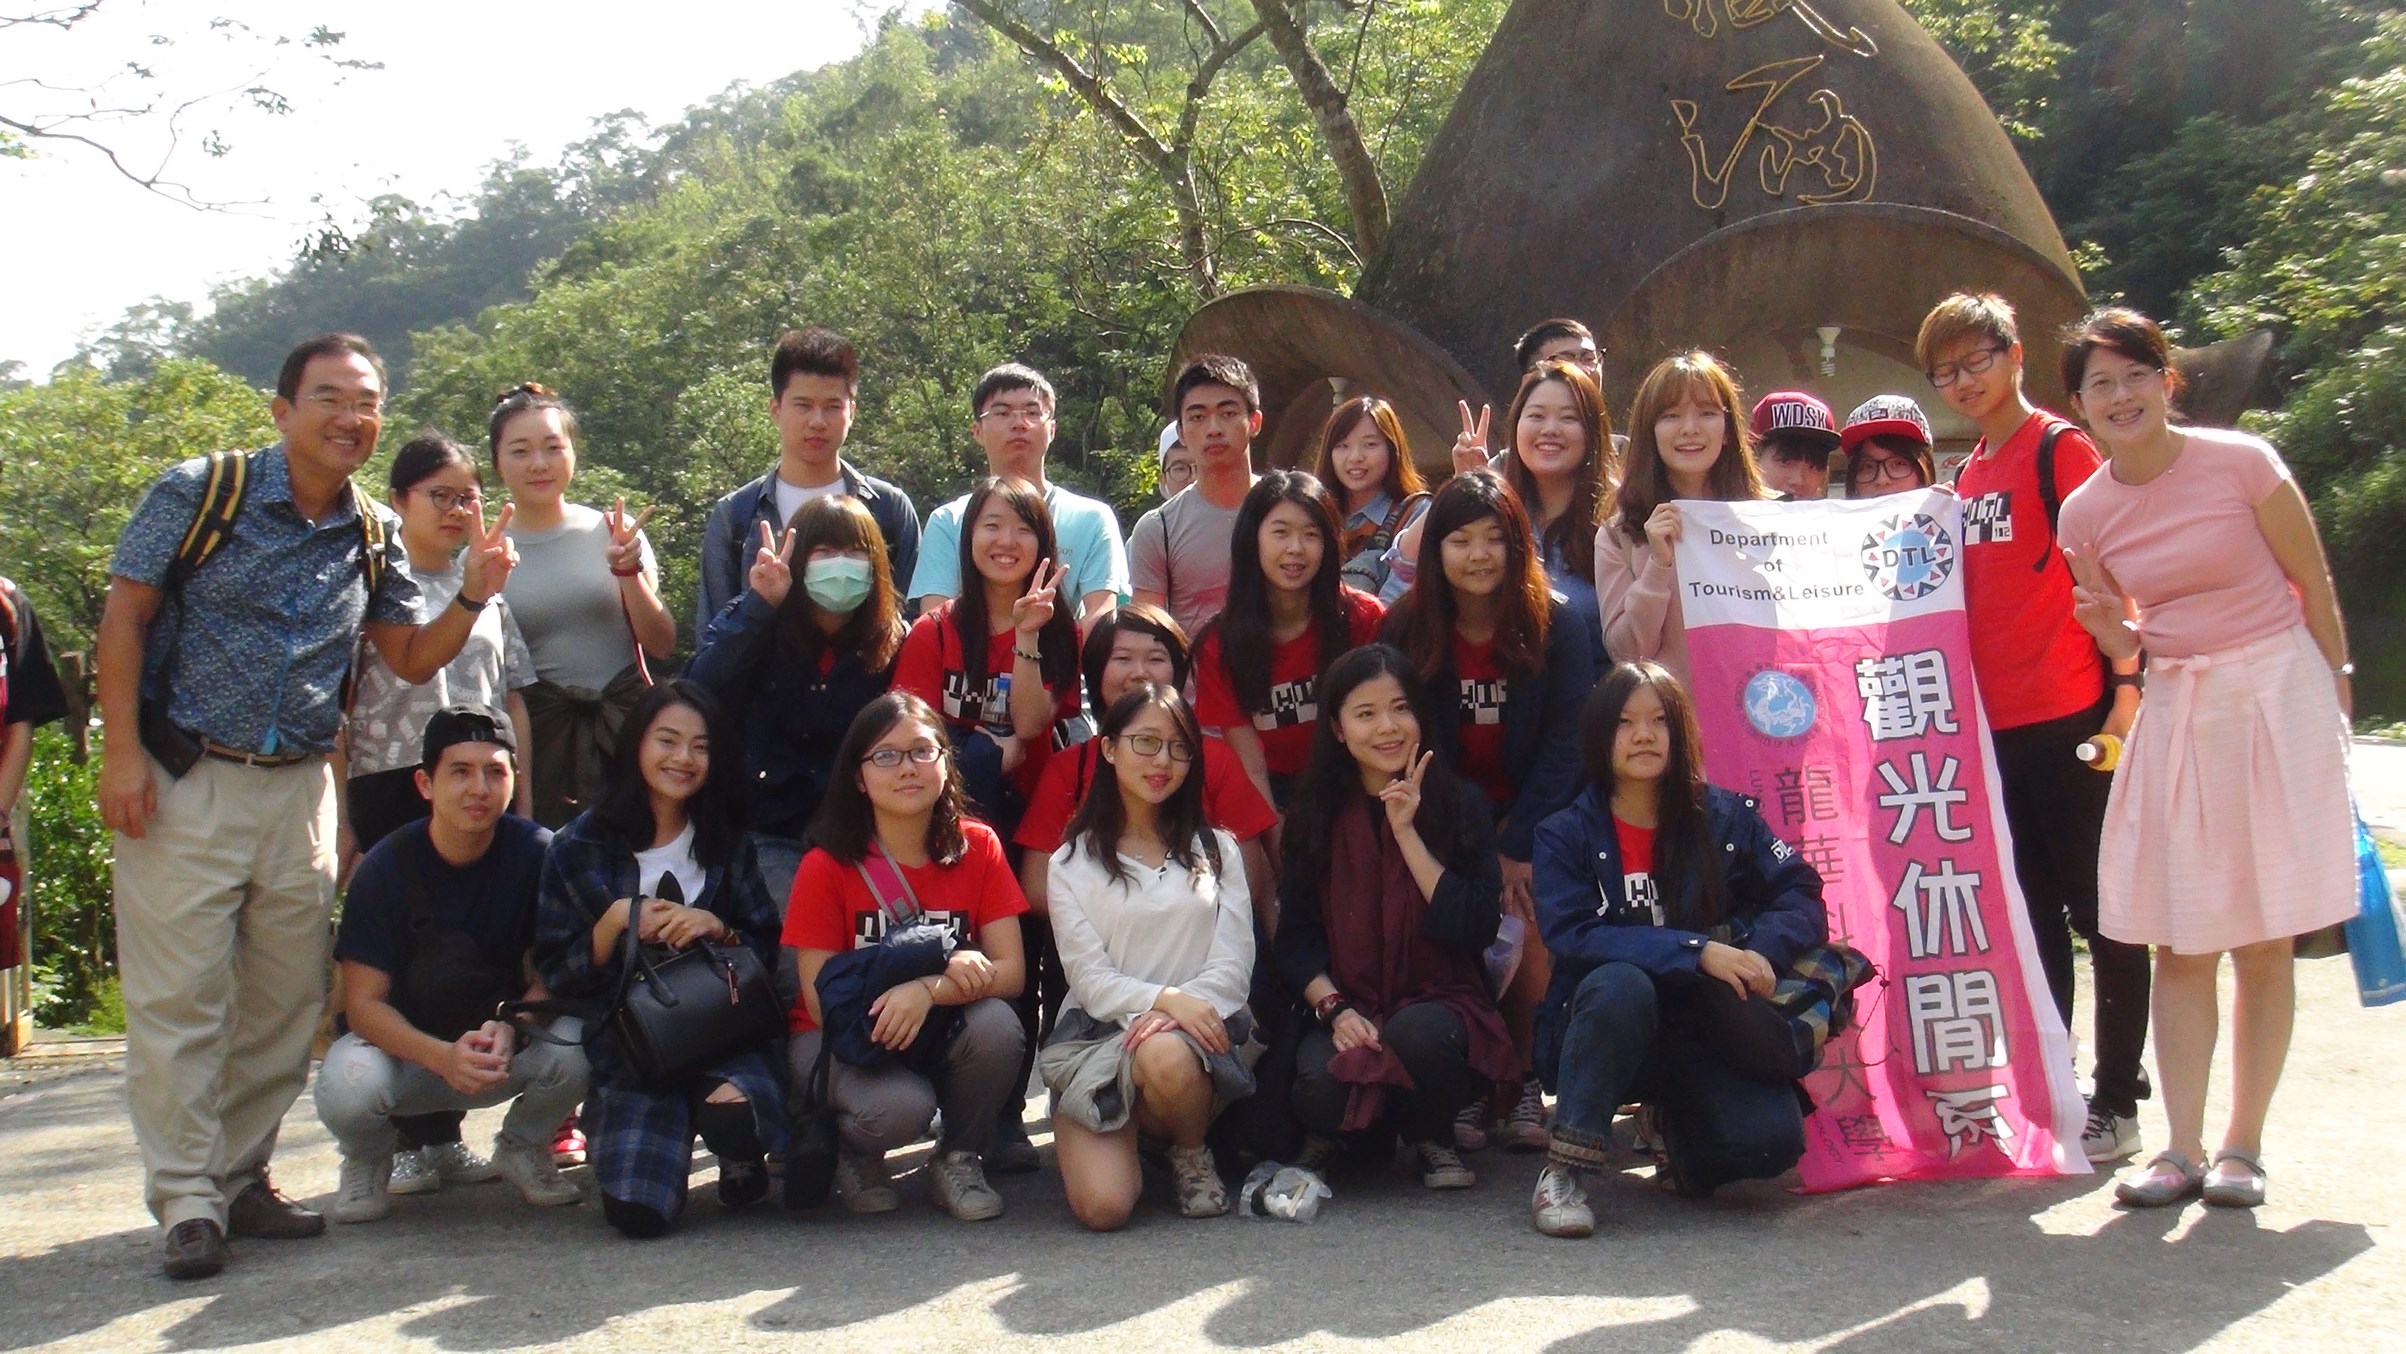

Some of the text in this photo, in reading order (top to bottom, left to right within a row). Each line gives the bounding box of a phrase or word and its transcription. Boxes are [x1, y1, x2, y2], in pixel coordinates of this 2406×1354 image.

[1771, 402, 1827, 429] WDSK
[1709, 529, 1829, 549] Department
[1764, 558, 1783, 572] of
[1882, 546, 1937, 567] DTL
[1689, 582, 1865, 601] Tourism&Leisure
